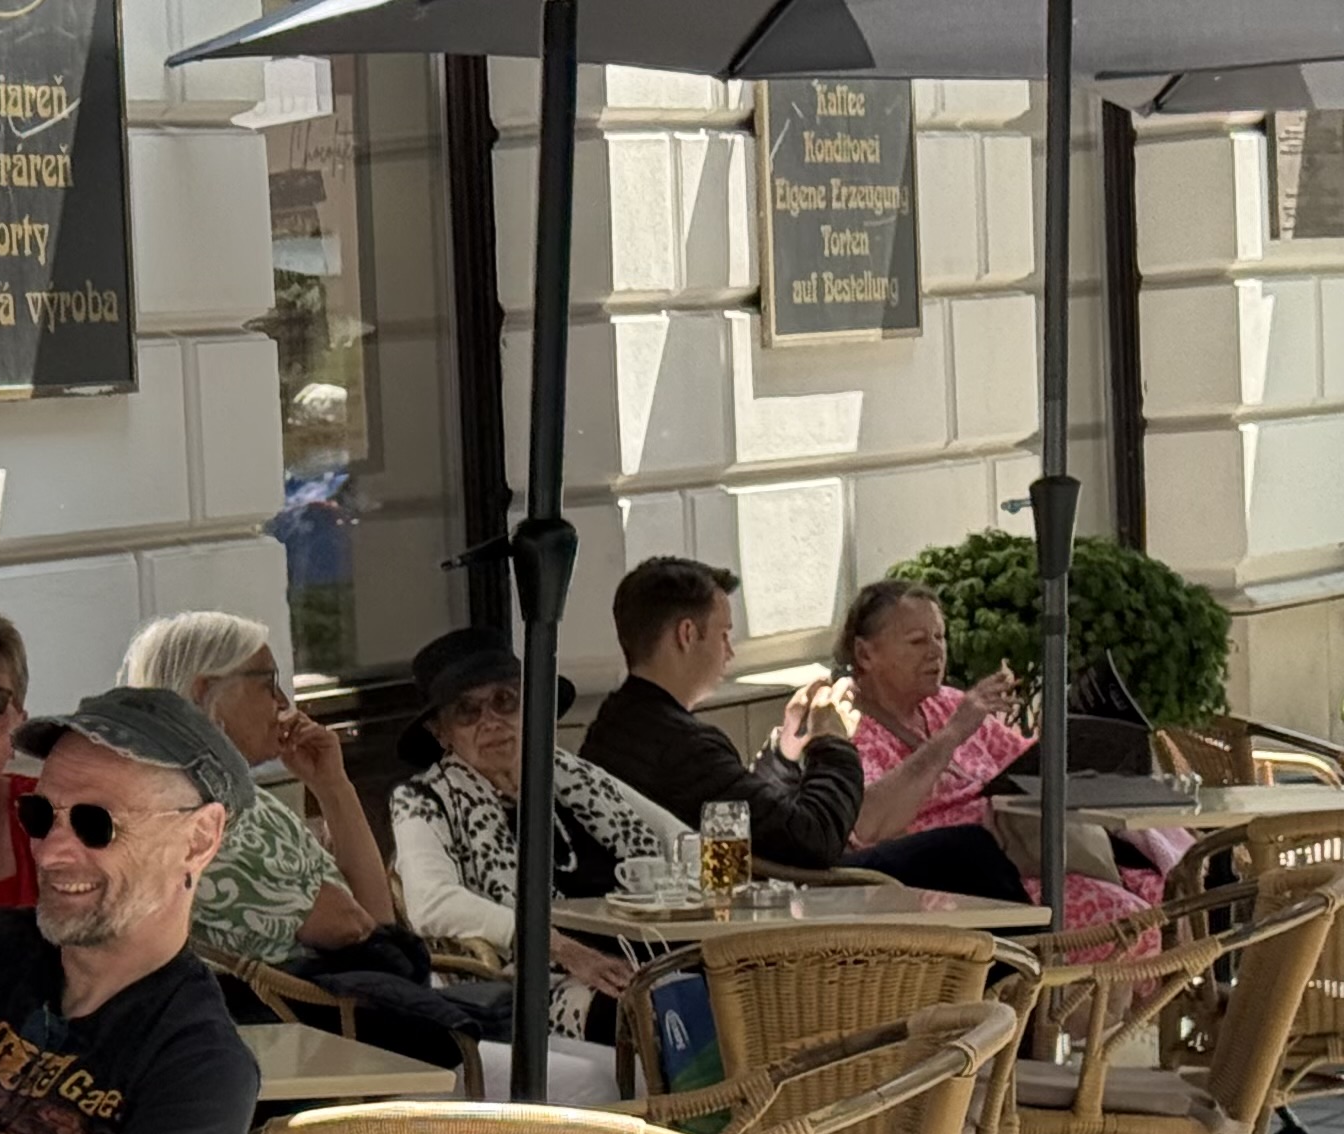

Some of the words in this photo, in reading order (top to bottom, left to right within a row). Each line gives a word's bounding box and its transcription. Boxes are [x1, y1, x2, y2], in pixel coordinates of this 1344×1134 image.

[815, 84, 866, 117] Kaffee
[803, 131, 880, 164] Konditorei
[775, 178, 827, 218] Eigene
[831, 178, 909, 217] Erzeugung
[820, 224, 870, 258] Torten
[25, 279, 120, 333] výroba
[792, 271, 818, 305] auf
[823, 270, 899, 307] Bestellung
